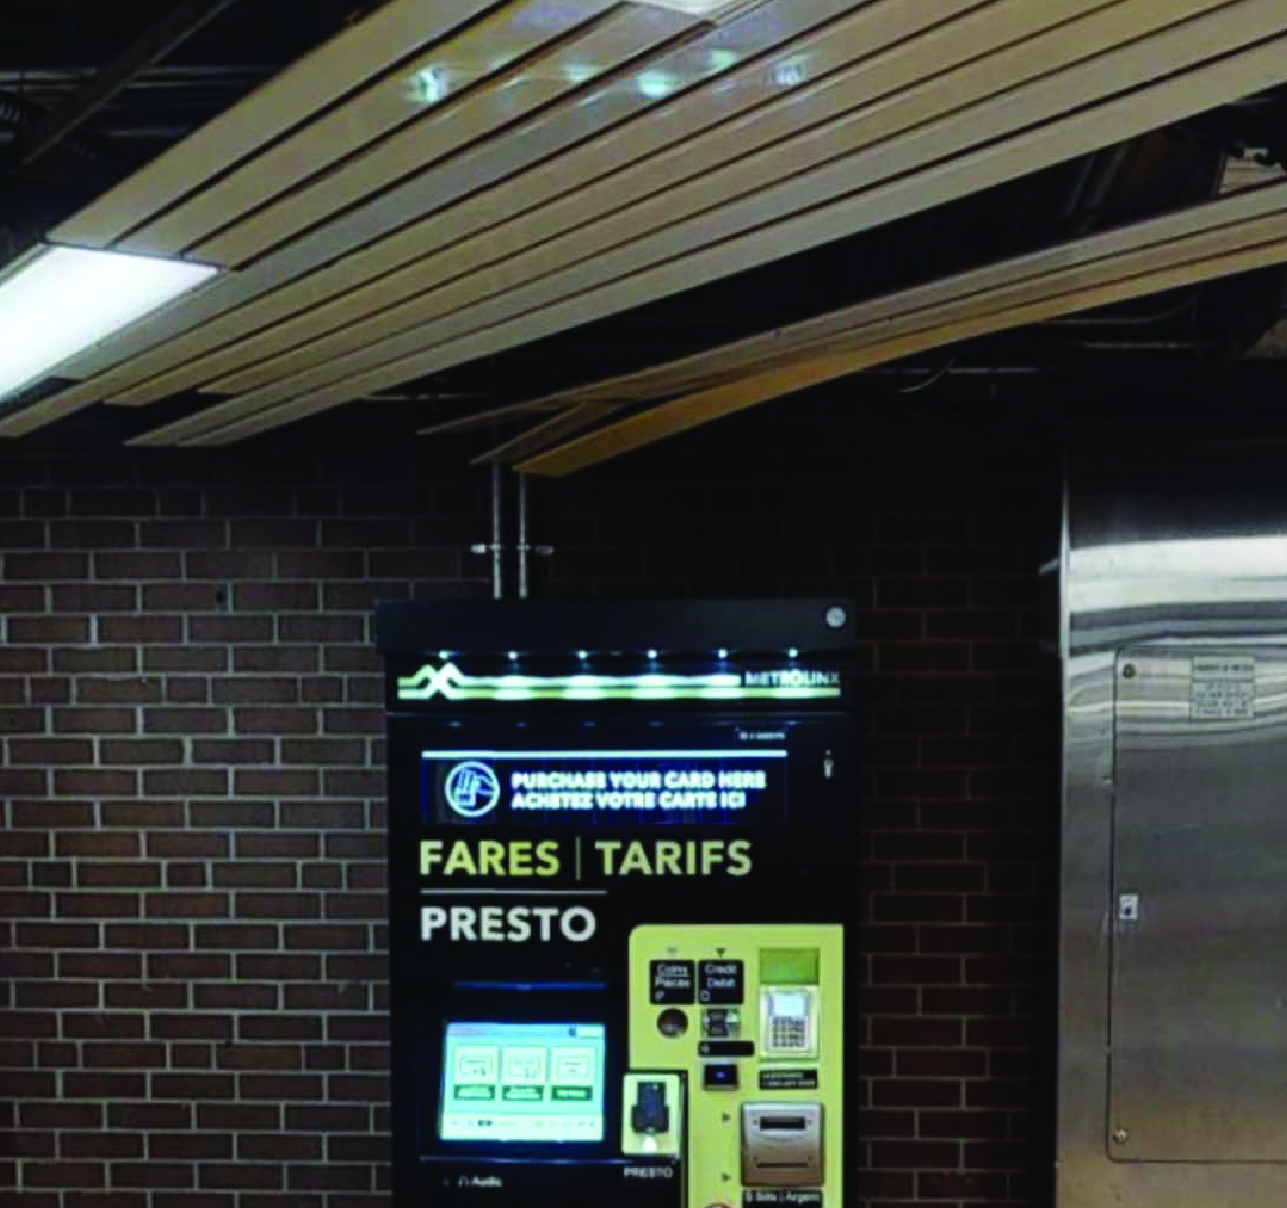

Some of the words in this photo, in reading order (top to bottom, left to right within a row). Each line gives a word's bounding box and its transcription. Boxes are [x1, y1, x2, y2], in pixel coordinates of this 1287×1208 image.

[745, 670, 840, 687] METROLINX
[511, 770, 607, 789] PURCHASE
[609, 770, 662, 789] YOUR
[664, 770, 716, 789] CARD
[718, 770, 767, 789] HERE
[511, 792, 594, 810] ACHETEZ
[596, 792, 657, 810] VOTRE
[660, 792, 717, 810] CARTE
[719, 792, 747, 810] ICI
[419, 840, 560, 877] FARES
[594, 840, 753, 877] TARIFS
[420, 906, 597, 942] PRESTO
[623, 1166, 674, 1178] PRESTO
